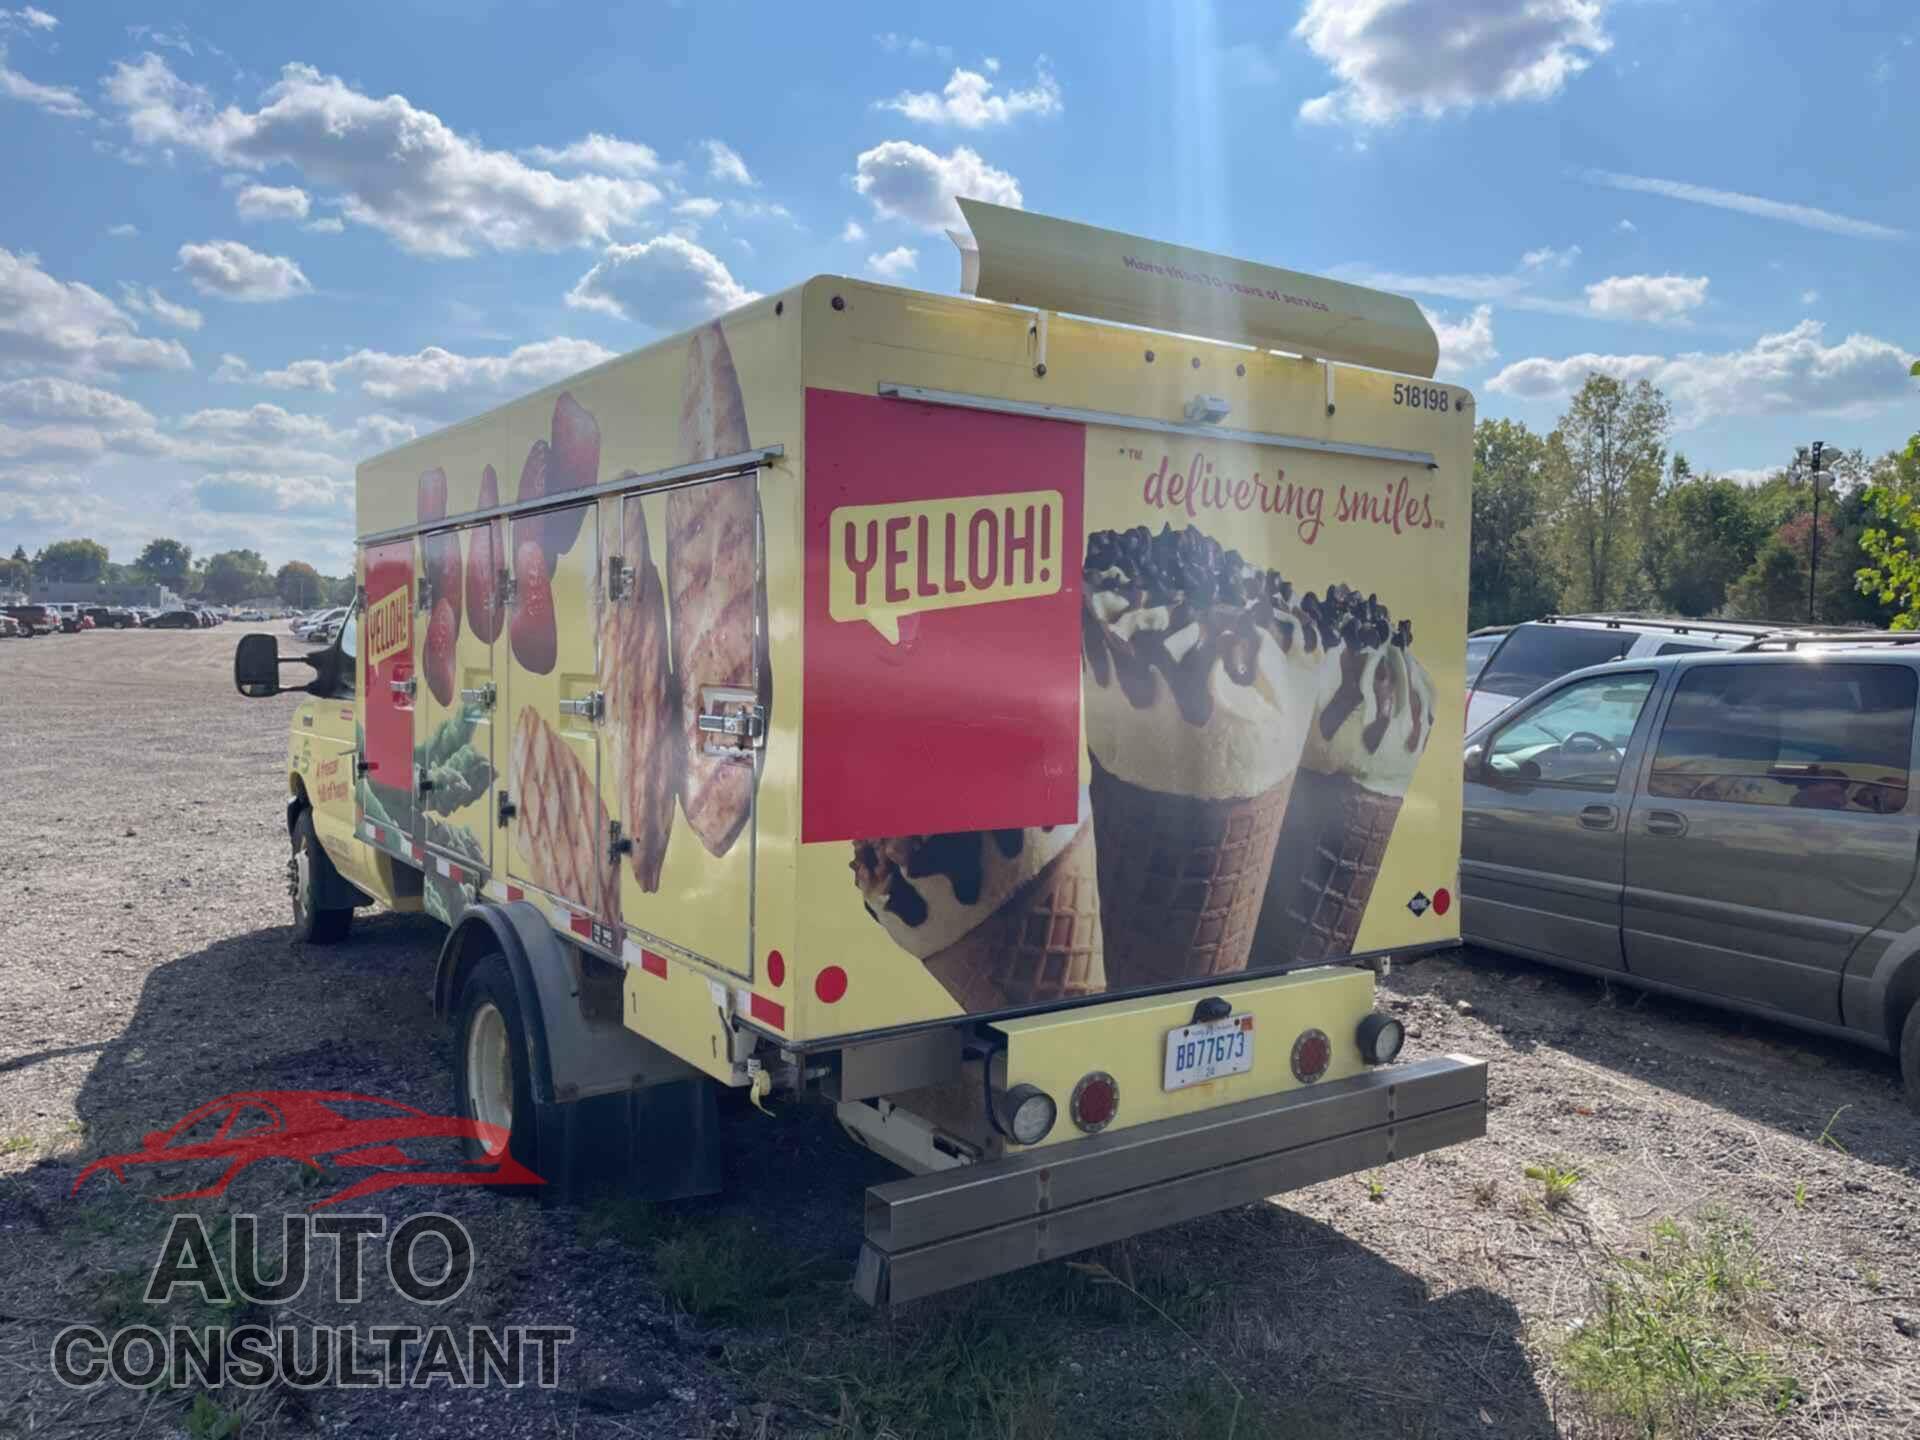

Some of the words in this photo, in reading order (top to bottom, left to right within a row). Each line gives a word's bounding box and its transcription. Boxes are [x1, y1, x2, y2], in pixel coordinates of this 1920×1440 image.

[1282, 293, 1329, 312] service
[1393, 383, 1449, 412] 518198
[1143, 453, 1325, 545] delivering
[1335, 476, 1432, 535] smiles
[844, 503, 1051, 605] YELLOH!
[369, 592, 407, 656] YELLOH!
[1176, 1032, 1245, 1072] BB77673
